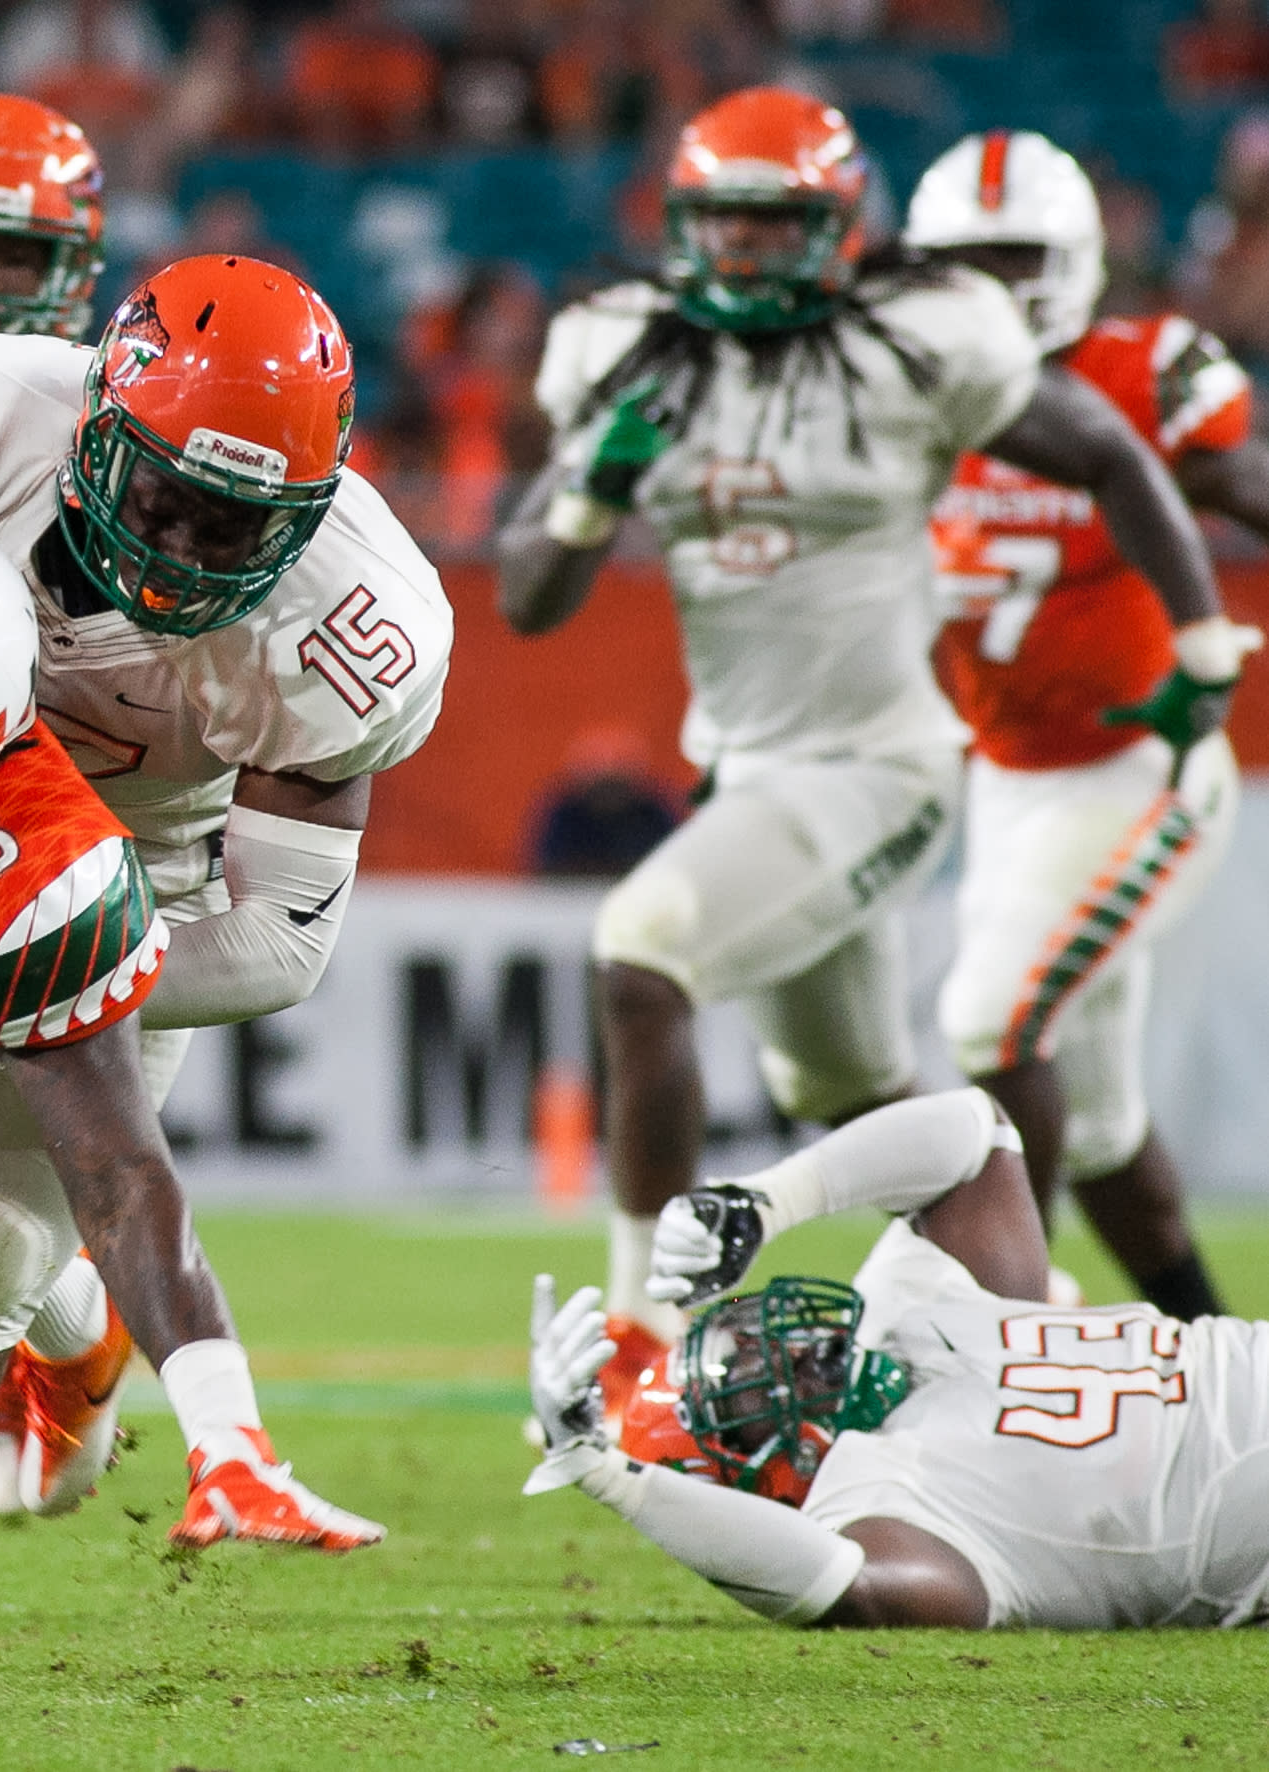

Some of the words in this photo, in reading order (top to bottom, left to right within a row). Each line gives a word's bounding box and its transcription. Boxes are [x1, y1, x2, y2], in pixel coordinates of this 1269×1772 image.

[211, 438, 266, 468] Riddell
[244, 523, 296, 568] Riddell
[297, 583, 416, 718] 15
